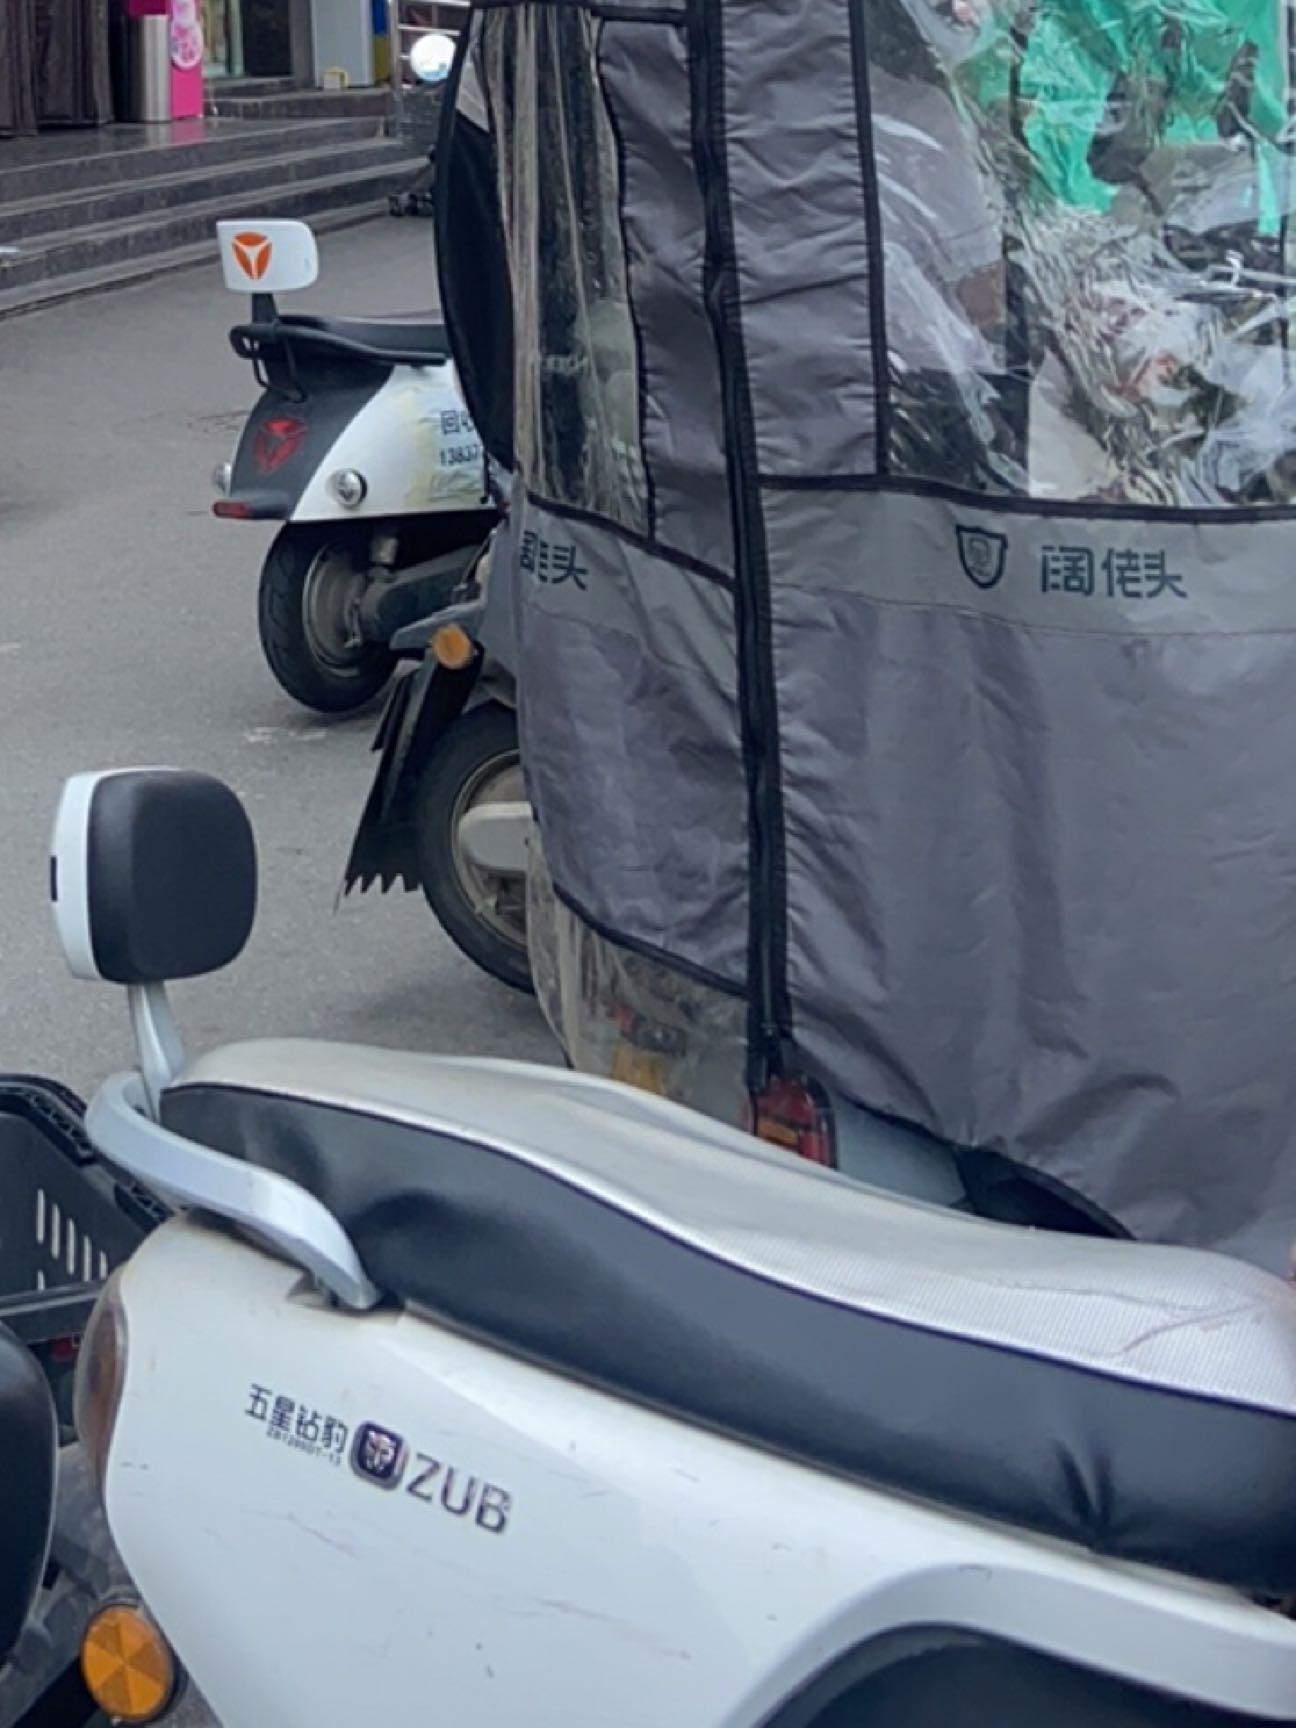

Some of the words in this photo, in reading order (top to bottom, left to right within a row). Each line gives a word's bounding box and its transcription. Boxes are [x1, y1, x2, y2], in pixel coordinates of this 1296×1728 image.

[245, 1383, 349, 1454] 五星钻豹
[405, 1452, 513, 1534] ZUB
